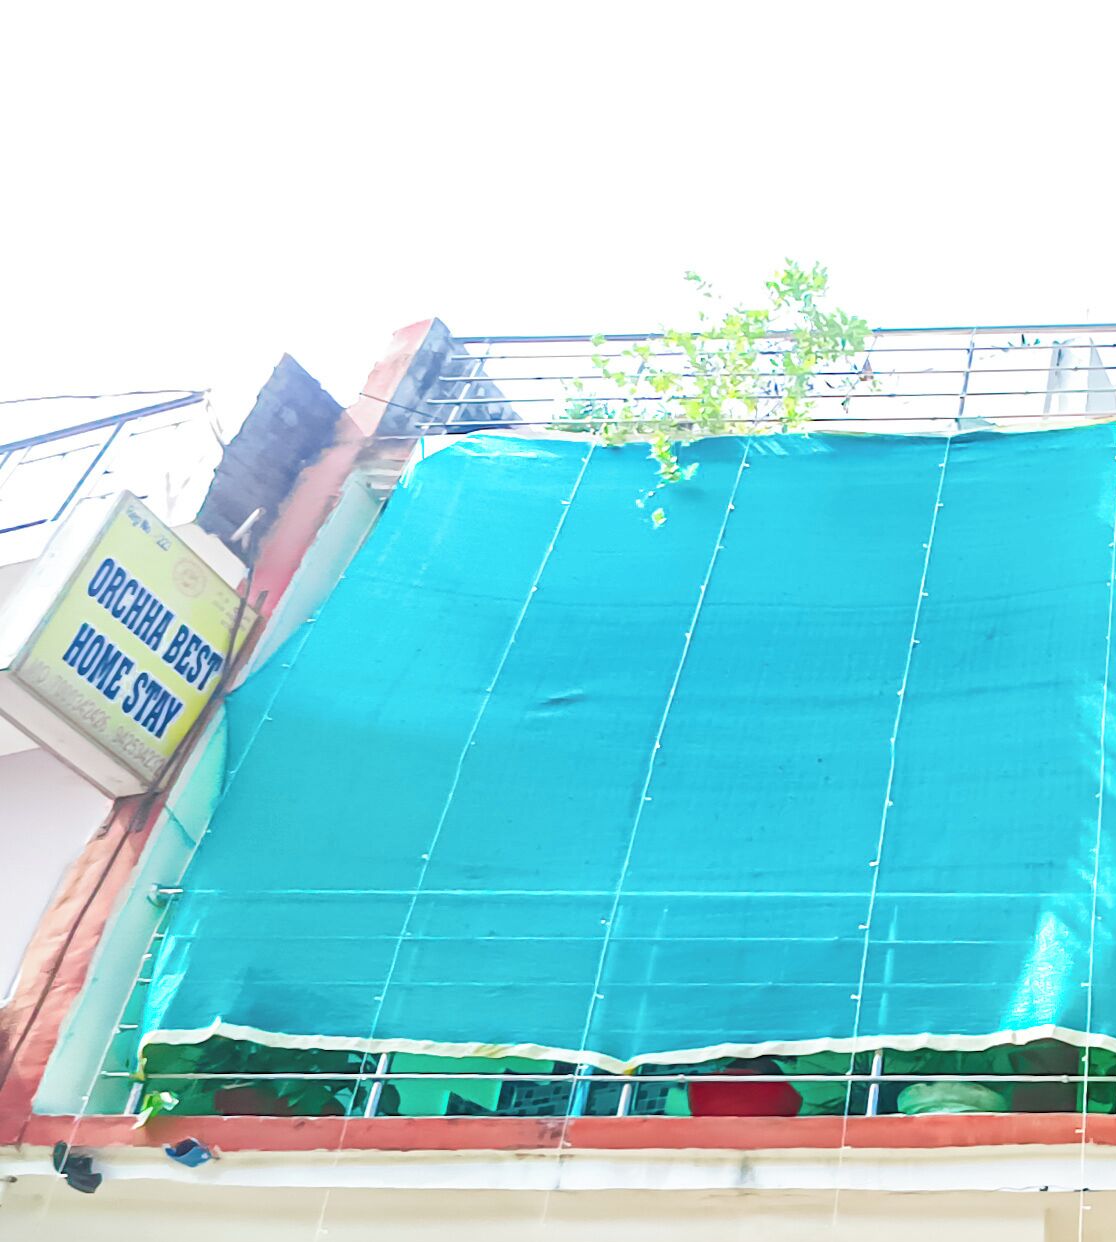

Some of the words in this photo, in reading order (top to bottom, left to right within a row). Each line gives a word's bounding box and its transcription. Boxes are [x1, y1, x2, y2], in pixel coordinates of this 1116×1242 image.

[62, 622, 134, 700] HOME
[122, 672, 184, 738] STAY
[87, 558, 174, 651] ORCHHA
[162, 624, 223, 690] BEST
